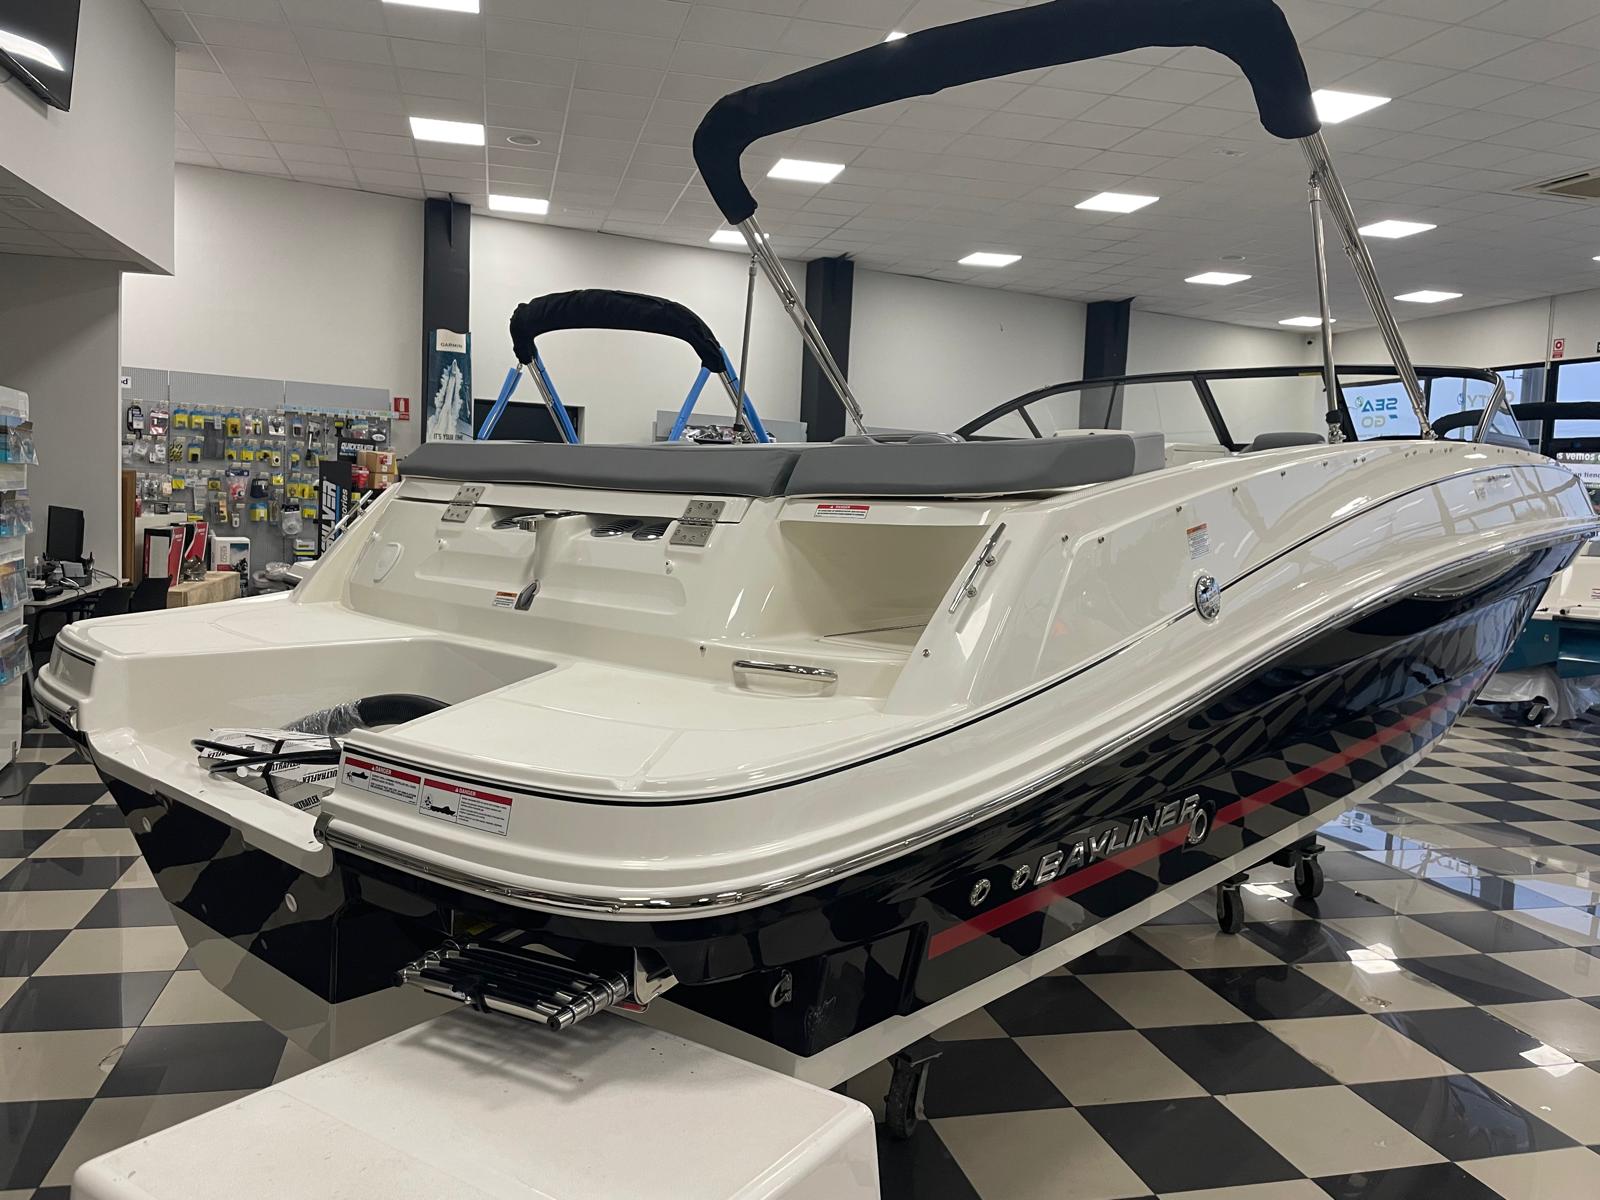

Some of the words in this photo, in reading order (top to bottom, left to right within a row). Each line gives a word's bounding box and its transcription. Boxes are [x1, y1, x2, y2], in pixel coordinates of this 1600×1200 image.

[1565, 451, 1596, 461] vemos
[375, 765, 392, 775] DANGER
[302, 770, 338, 784] ULTRAFLEX
[459, 787, 476, 796] DANGER
[1034, 793, 1200, 886] BAYLINER
